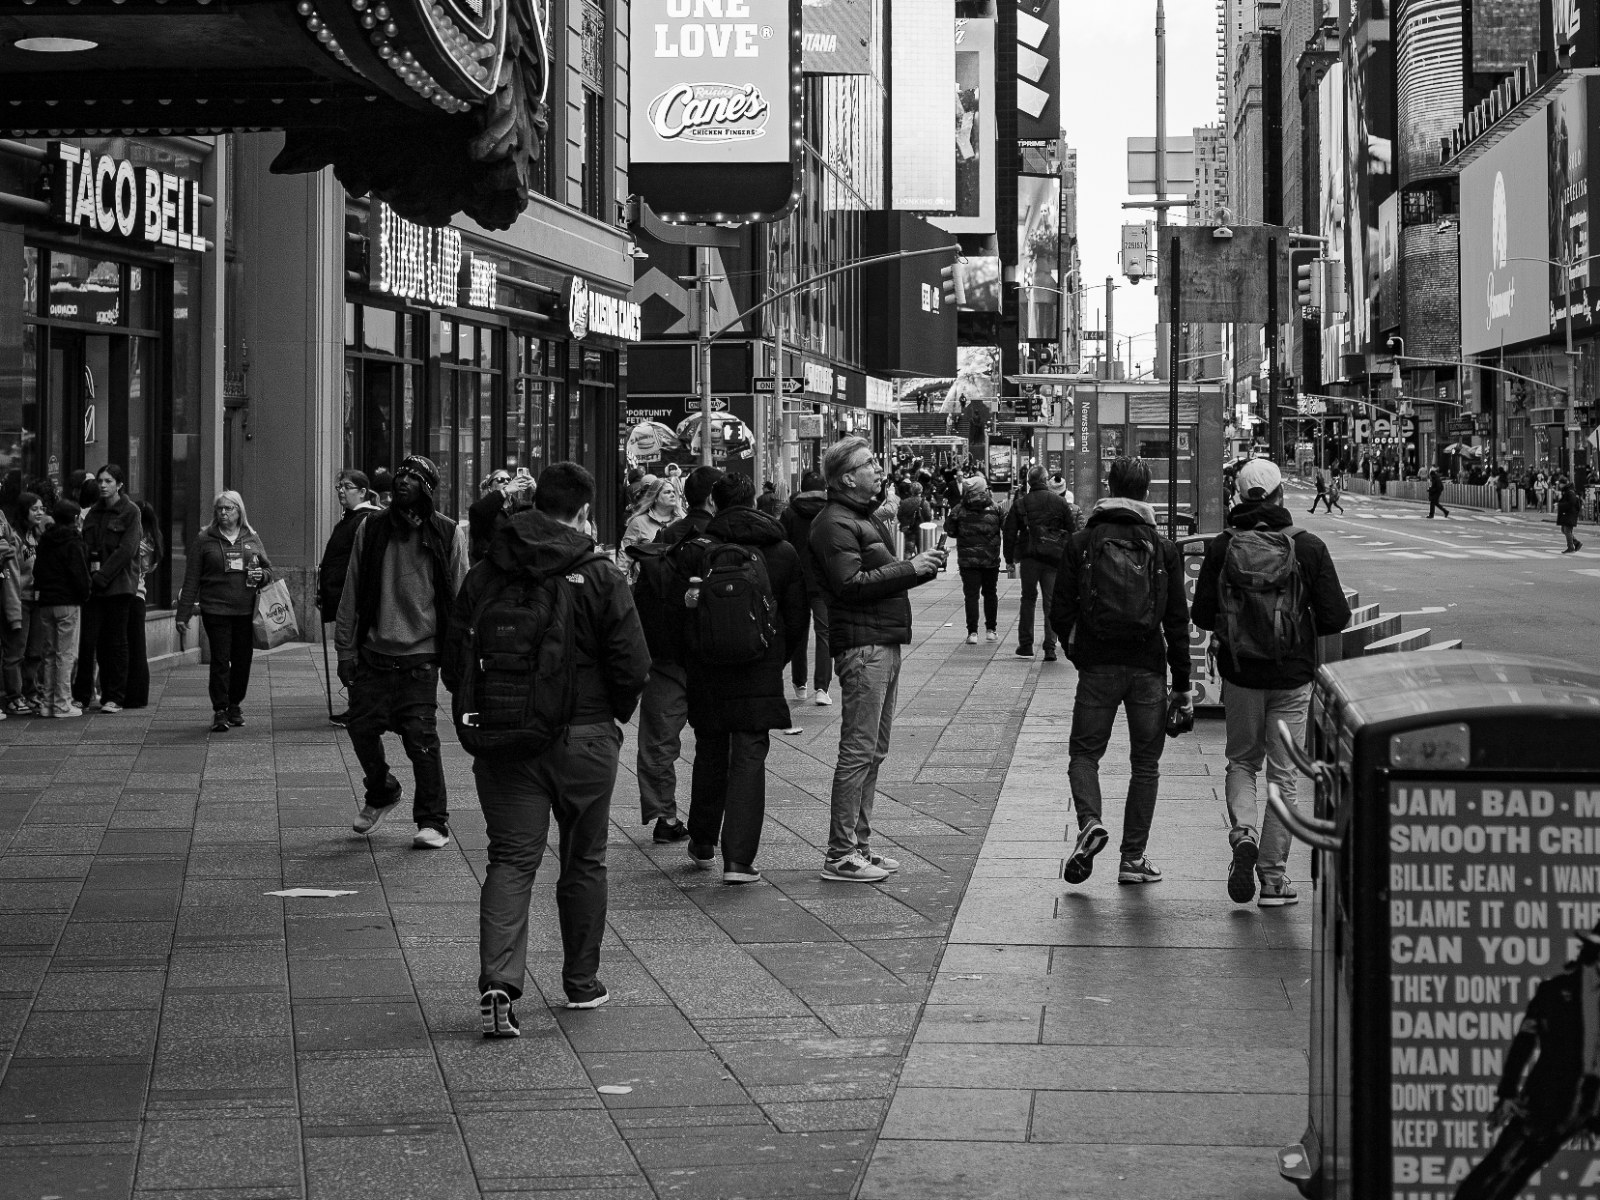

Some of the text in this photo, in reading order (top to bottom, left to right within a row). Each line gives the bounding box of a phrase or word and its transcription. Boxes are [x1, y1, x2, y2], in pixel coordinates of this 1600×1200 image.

[1474, 51, 1538, 137] BROADWAY
[655, 83, 767, 139] Cane's
[692, 128, 755, 137] CHICKEN FINGERS
[60, 141, 206, 252] TACO BELL
[627, 409, 672, 417] PORTUNITY
[1082, 401, 1091, 453] Newsstand
[1185, 556, 1206, 704] CHICGO
[1390, 789, 1456, 816] JAM
[1482, 790, 1555, 817] BAD
[1390, 825, 1600, 854] SMOOTH CRI
[1390, 864, 1454, 891] BILLIE
[1459, 864, 1516, 892] JEAN
[1541, 865, 1548, 893] I
[1390, 900, 1471, 927] BLAME
[1480, 901, 1504, 928] IT
[1514, 901, 1548, 929] ON
[1391, 935, 1463, 964] CAN
[1478, 936, 1551, 965] YOU
[1391, 975, 1448, 1002] THEY
[1455, 976, 1522, 1004] DON'T
[1392, 1047, 1460, 1075] MAN
[1392, 1084, 1447, 1111] DON'T
[1392, 1120, 1438, 1147] KEEP
[1442, 1121, 1479, 1148] THE
[1393, 1155, 1485, 1184] BEA
